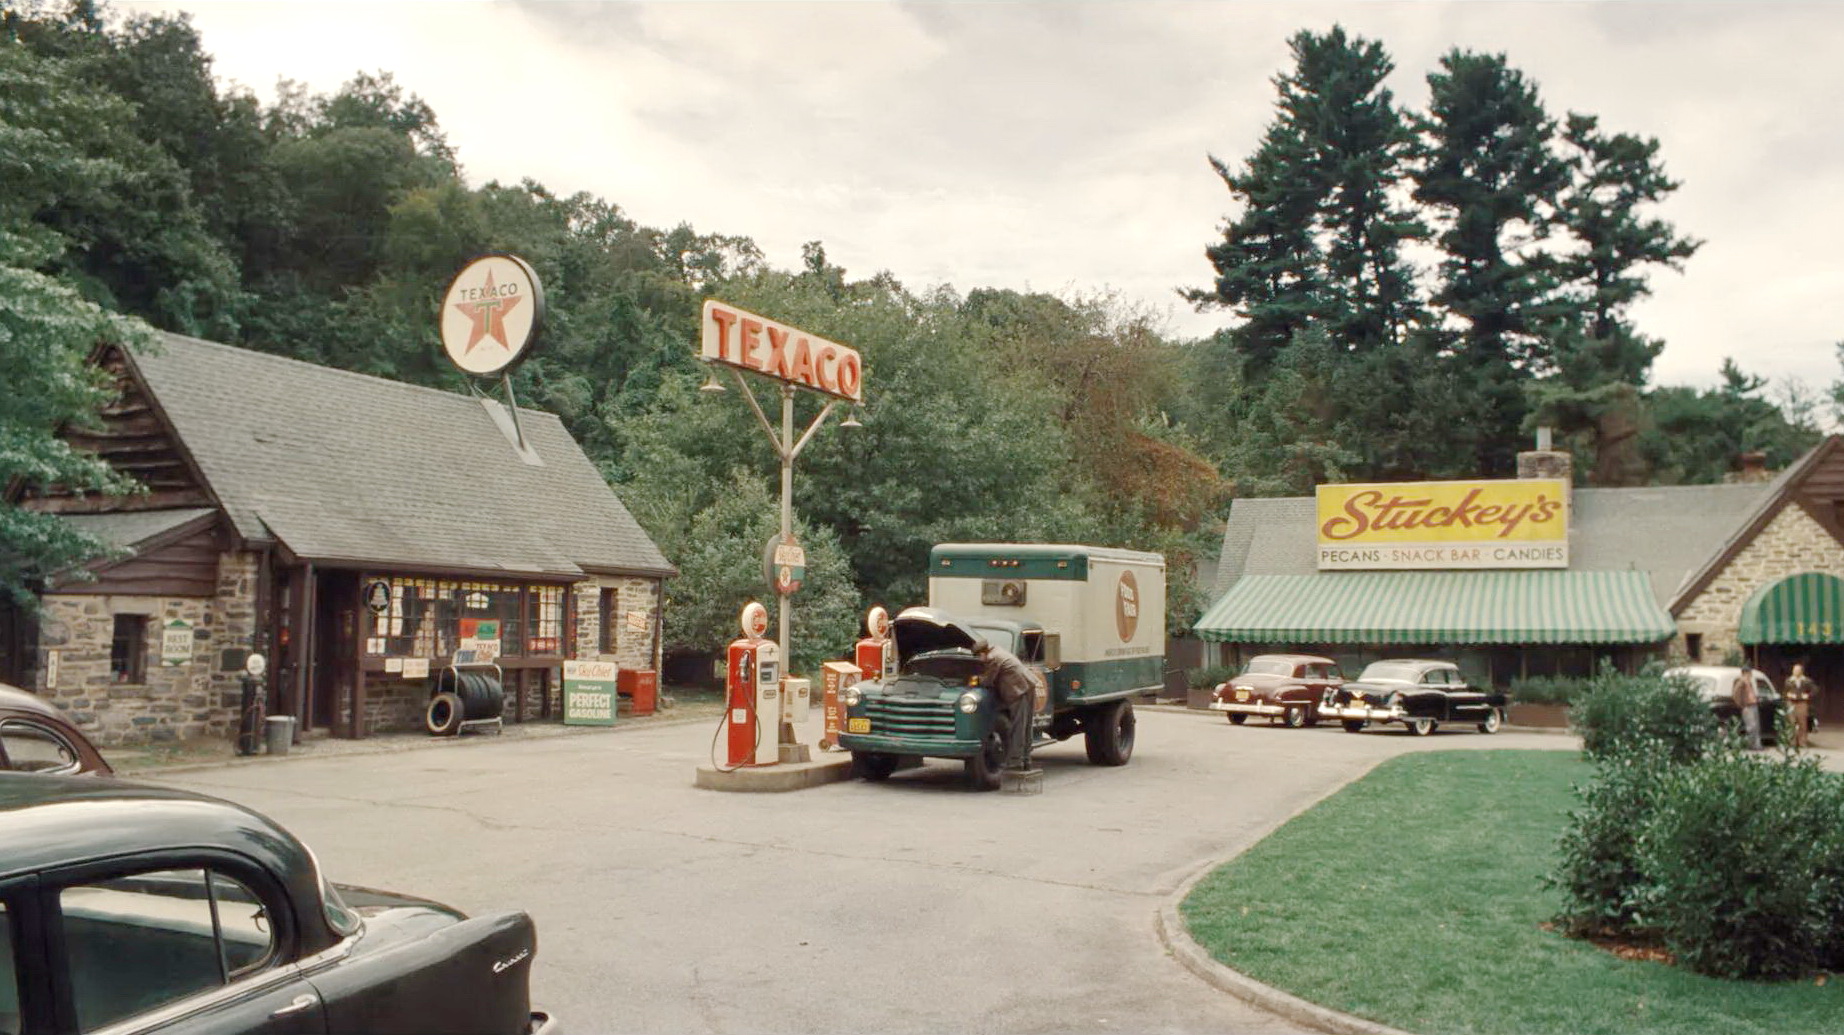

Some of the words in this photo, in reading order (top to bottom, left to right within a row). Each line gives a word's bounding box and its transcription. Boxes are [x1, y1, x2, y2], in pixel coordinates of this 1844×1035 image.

[460, 283, 518, 301] TEXACO
[712, 308, 860, 396] TEXACO
[1321, 488, 1562, 540] Stuckey's
[1321, 550, 1380, 562] PECANS
[1392, 549, 1444, 562] SNACK
[1451, 548, 1481, 561] BAR
[1493, 547, 1564, 561] CANDIES
[569, 692, 612, 709] PERFECT
[568, 708, 612, 719] GASOLINE
